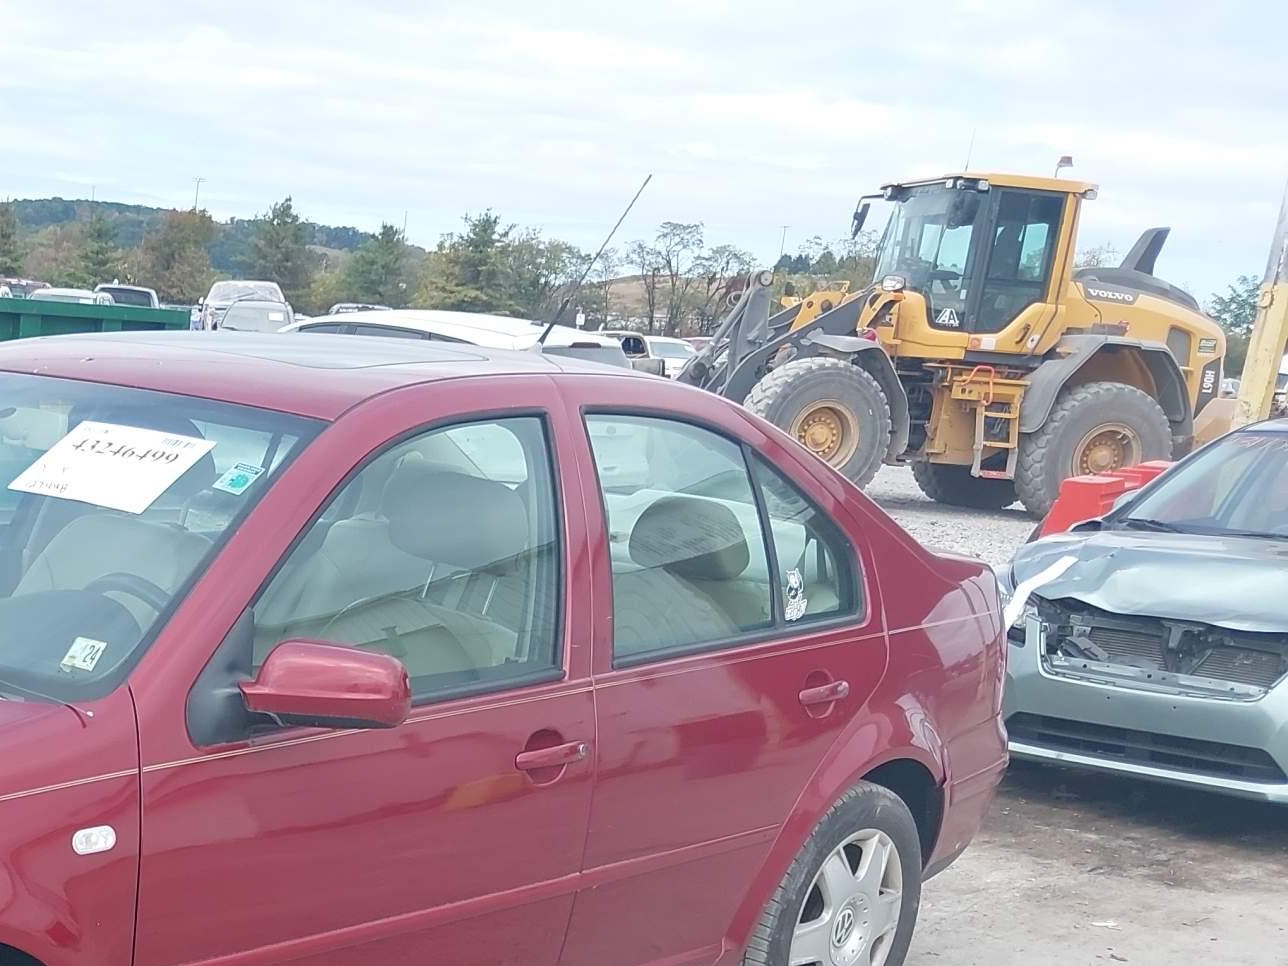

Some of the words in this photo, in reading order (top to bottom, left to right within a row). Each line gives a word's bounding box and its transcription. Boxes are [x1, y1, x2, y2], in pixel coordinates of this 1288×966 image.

[1087, 288, 1134, 302] VOLVO
[1201, 369, 1216, 394] L90H
[72, 438, 180, 466] 43246499
